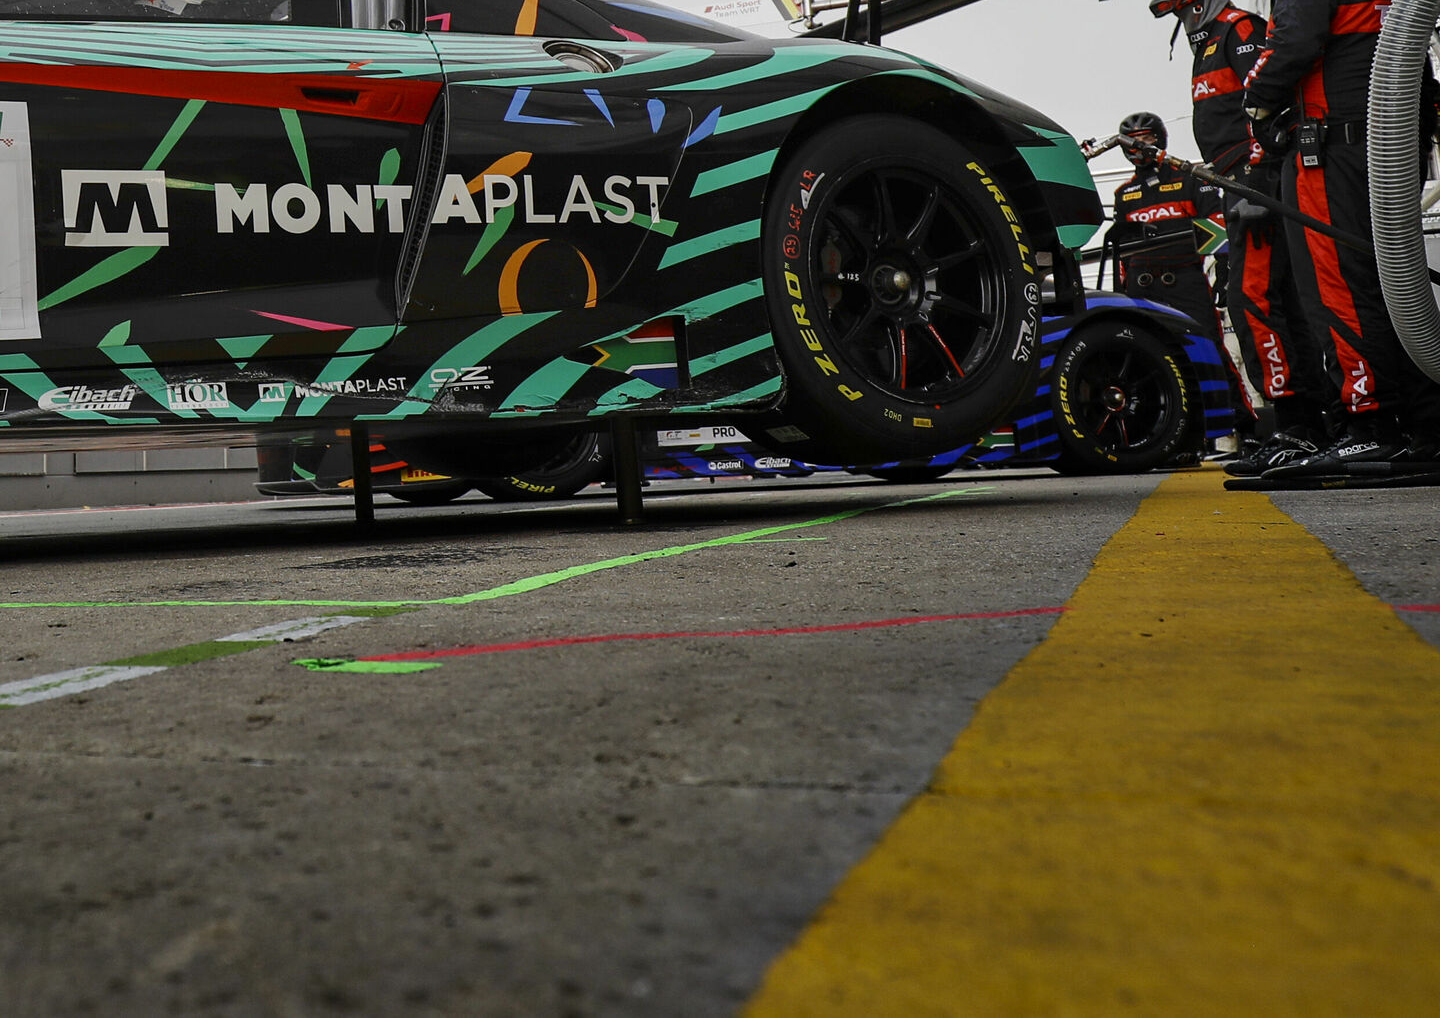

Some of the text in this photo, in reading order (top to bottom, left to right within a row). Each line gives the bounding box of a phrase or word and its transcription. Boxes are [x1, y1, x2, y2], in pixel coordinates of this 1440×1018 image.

[714, 0, 761, 11] Audi Sport
[715, 6, 760, 18] Team WRT
[966, 161, 1034, 275] PIRELLI
[1130, 206, 1182, 222] TOTAL
[784, 270, 863, 401] P ZERO
[1264, 333, 1284, 398] TOTAL
[295, 377, 407, 399] MONTAPLAST
[1164, 355, 1188, 412] PIRELLI
[38, 384, 138, 411] Eibach
[1060, 376, 1085, 438] P ZERO
[883, 408, 902, 422] DHD2
[712, 427, 735, 438] PRO
[716, 461, 741, 470] Castrol
[754, 457, 791, 468] Eibach
